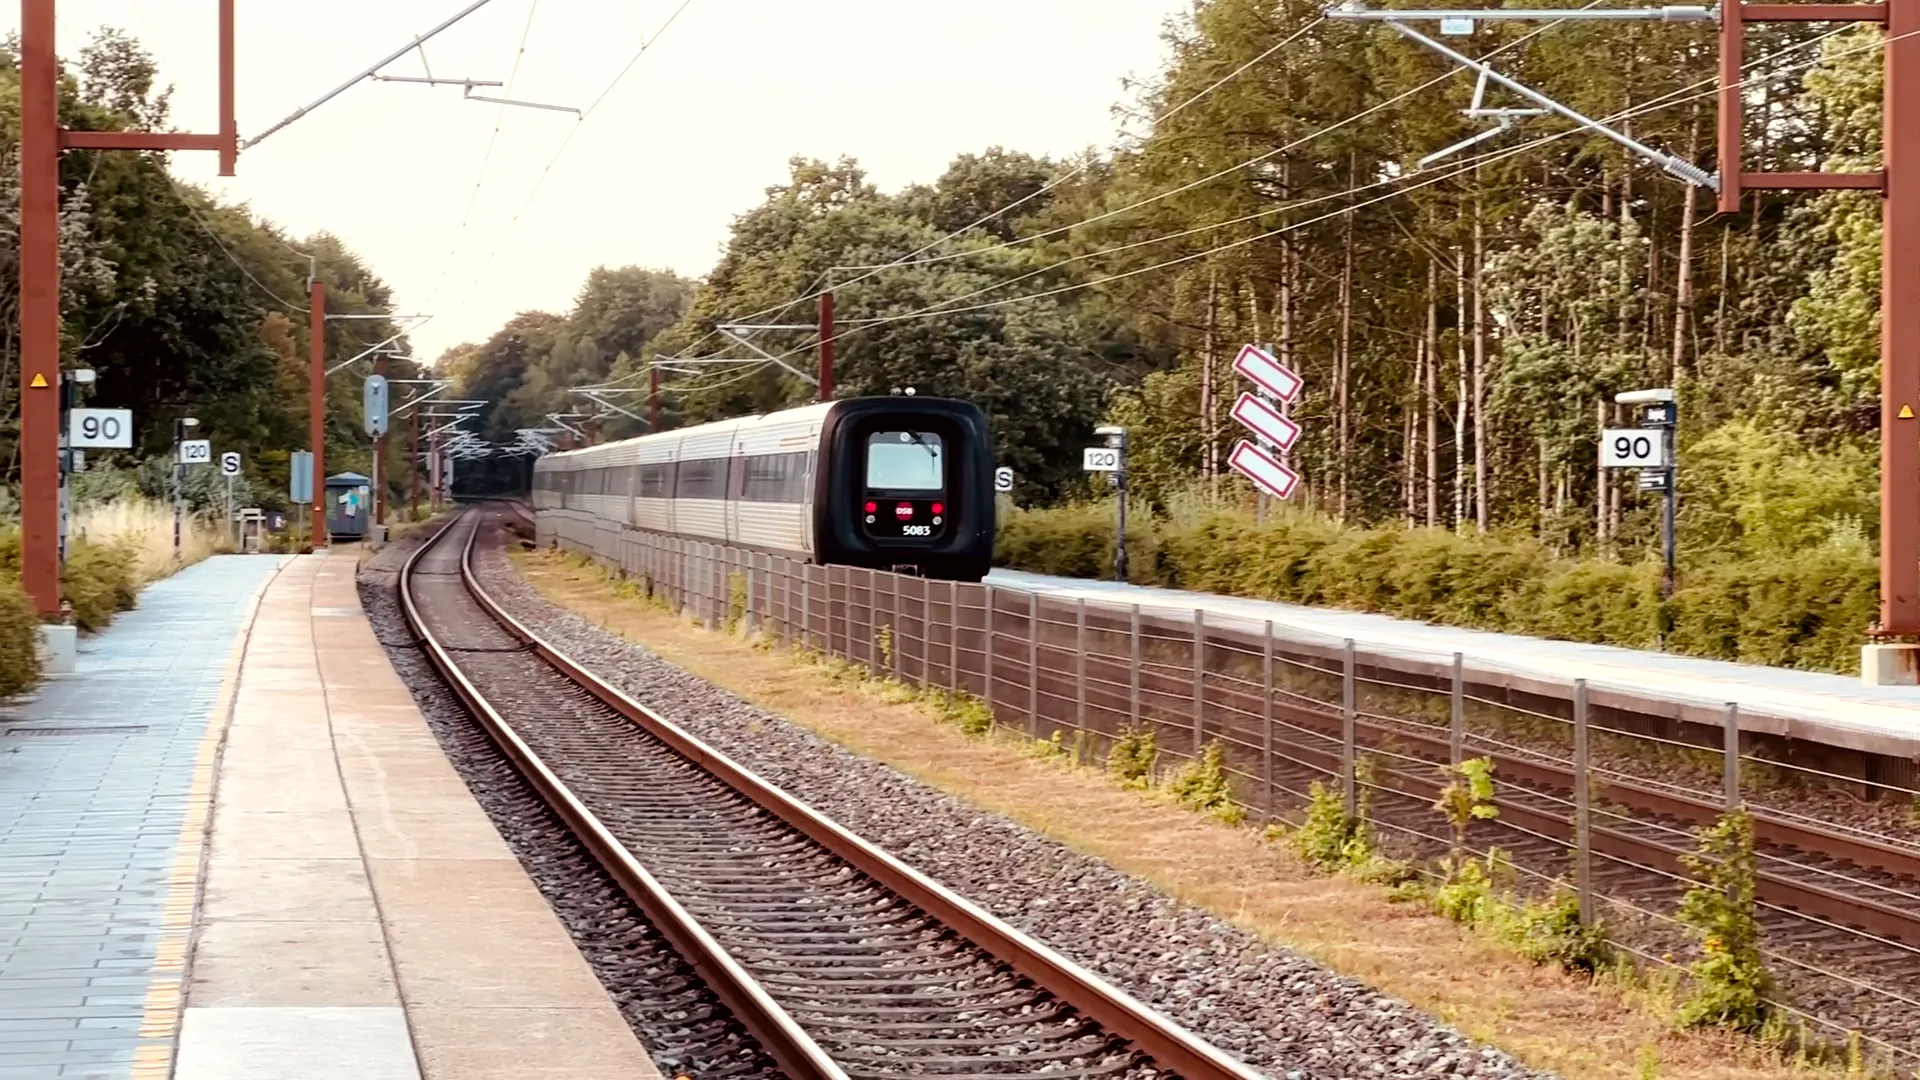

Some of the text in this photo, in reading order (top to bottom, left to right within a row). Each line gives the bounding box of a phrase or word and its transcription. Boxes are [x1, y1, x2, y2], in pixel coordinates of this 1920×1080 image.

[82, 416, 120, 440] 90
[185, 444, 207, 458] 120
[1614, 436, 1651, 459] 90
[224, 456, 238, 471] S
[1088, 453, 1115, 466] 120
[997, 471, 1011, 488] S
[896, 507, 913, 515] DSB
[903, 525, 930, 536] 5083
